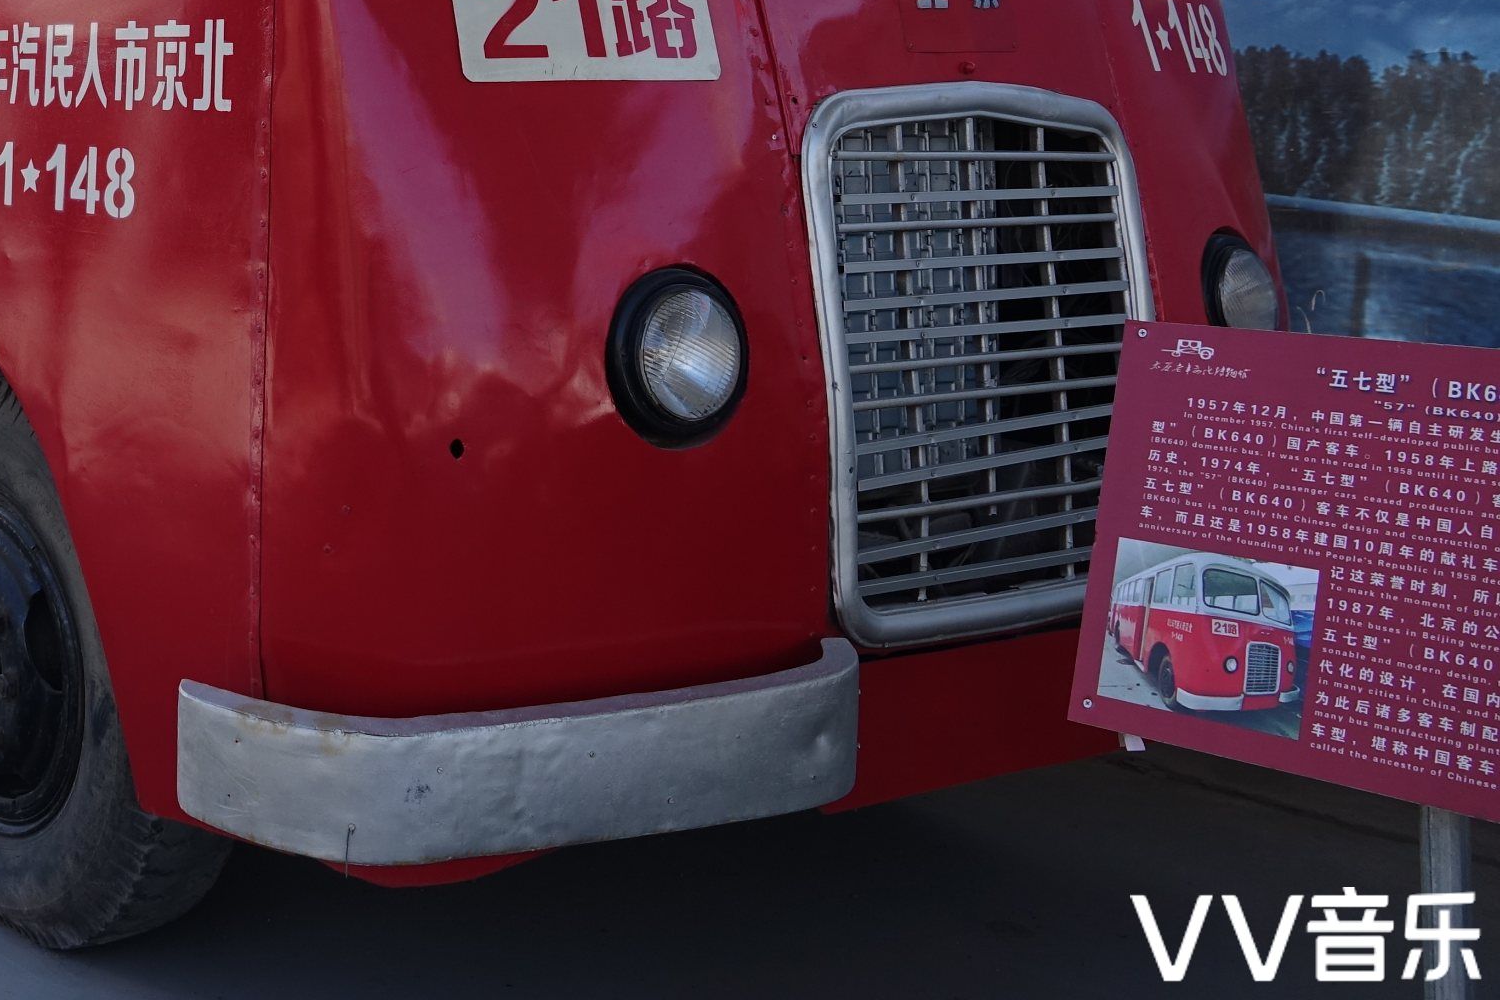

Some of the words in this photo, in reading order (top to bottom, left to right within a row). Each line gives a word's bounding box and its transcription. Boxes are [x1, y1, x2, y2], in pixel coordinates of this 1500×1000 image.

[1197, 413, 1245, 424] December
[1281, 423, 1319, 433] China's
[1325, 428, 1347, 437] first
[1352, 432, 1438, 447] self-developed
[1443, 443, 1480, 452] public
[1192, 442, 1238, 453] domestic
[1242, 448, 1263, 456] bus.
[1321, 458, 1338, 466] the
[1388, 466, 1412, 475] 1958
[1417, 471, 1445, 479] until
[1464, 477, 1486, 485] was
[1273, 483, 1327, 495] passenger
[1364, 496, 1402, 506] ceased
[1409, 502, 1473, 516] production
[1185, 499, 1202, 507] bus
[1244, 510, 1266, 518] only
[1294, 515, 1336, 527] Chinese
[1342, 523, 1379, 534] design
[1385, 530, 1405, 538] and
[1411, 534, 1487, 550] construction
[1139, 523, 1197, 537] anniversary
[1216, 534, 1232, 542] the
[1237, 537, 1283, 552] founding
[1304, 548, 1320, 556] the
[1326, 551, 1372, 564] People's
[1378, 559, 1428, 573] Republic
[1433, 568, 1444, 576] in
[1451, 571, 1476, 581] 1958
[1330, 583, 1342, 591] To
[1347, 588, 1374, 597] mark
[1381, 593, 1398, 601] the
[1404, 597, 1451, 610] moment
[1345, 618, 1363, 627] the
[1368, 622, 1400, 634] buses
[1406, 629, 1416, 637] in
[1422, 632, 1464, 647] Beijing
[1470, 642, 1500, 652] were
[1322, 647, 1366, 660] sonable
[1371, 657, 1391, 665] and
[1397, 662, 1441, 675] modern
[1319, 677, 1328, 685] in
[1334, 682, 1363, 693] many
[1368, 689, 1400, 700] cities
[1406, 695, 1417, 703] in
[1467, 709, 1488, 718] and
[1314, 710, 1343, 722] many
[1349, 716, 1368, 726] bus
[1374, 723, 1461, 748] manufacturing
[1468, 744, 1500, 755] plant
[1310, 743, 1344, 755] called
[1349, 750, 1367, 760] the
[1373, 756, 1424, 773] ancestor
[1430, 769, 1442, 777] of
[1447, 772, 1497, 790] Chinese
